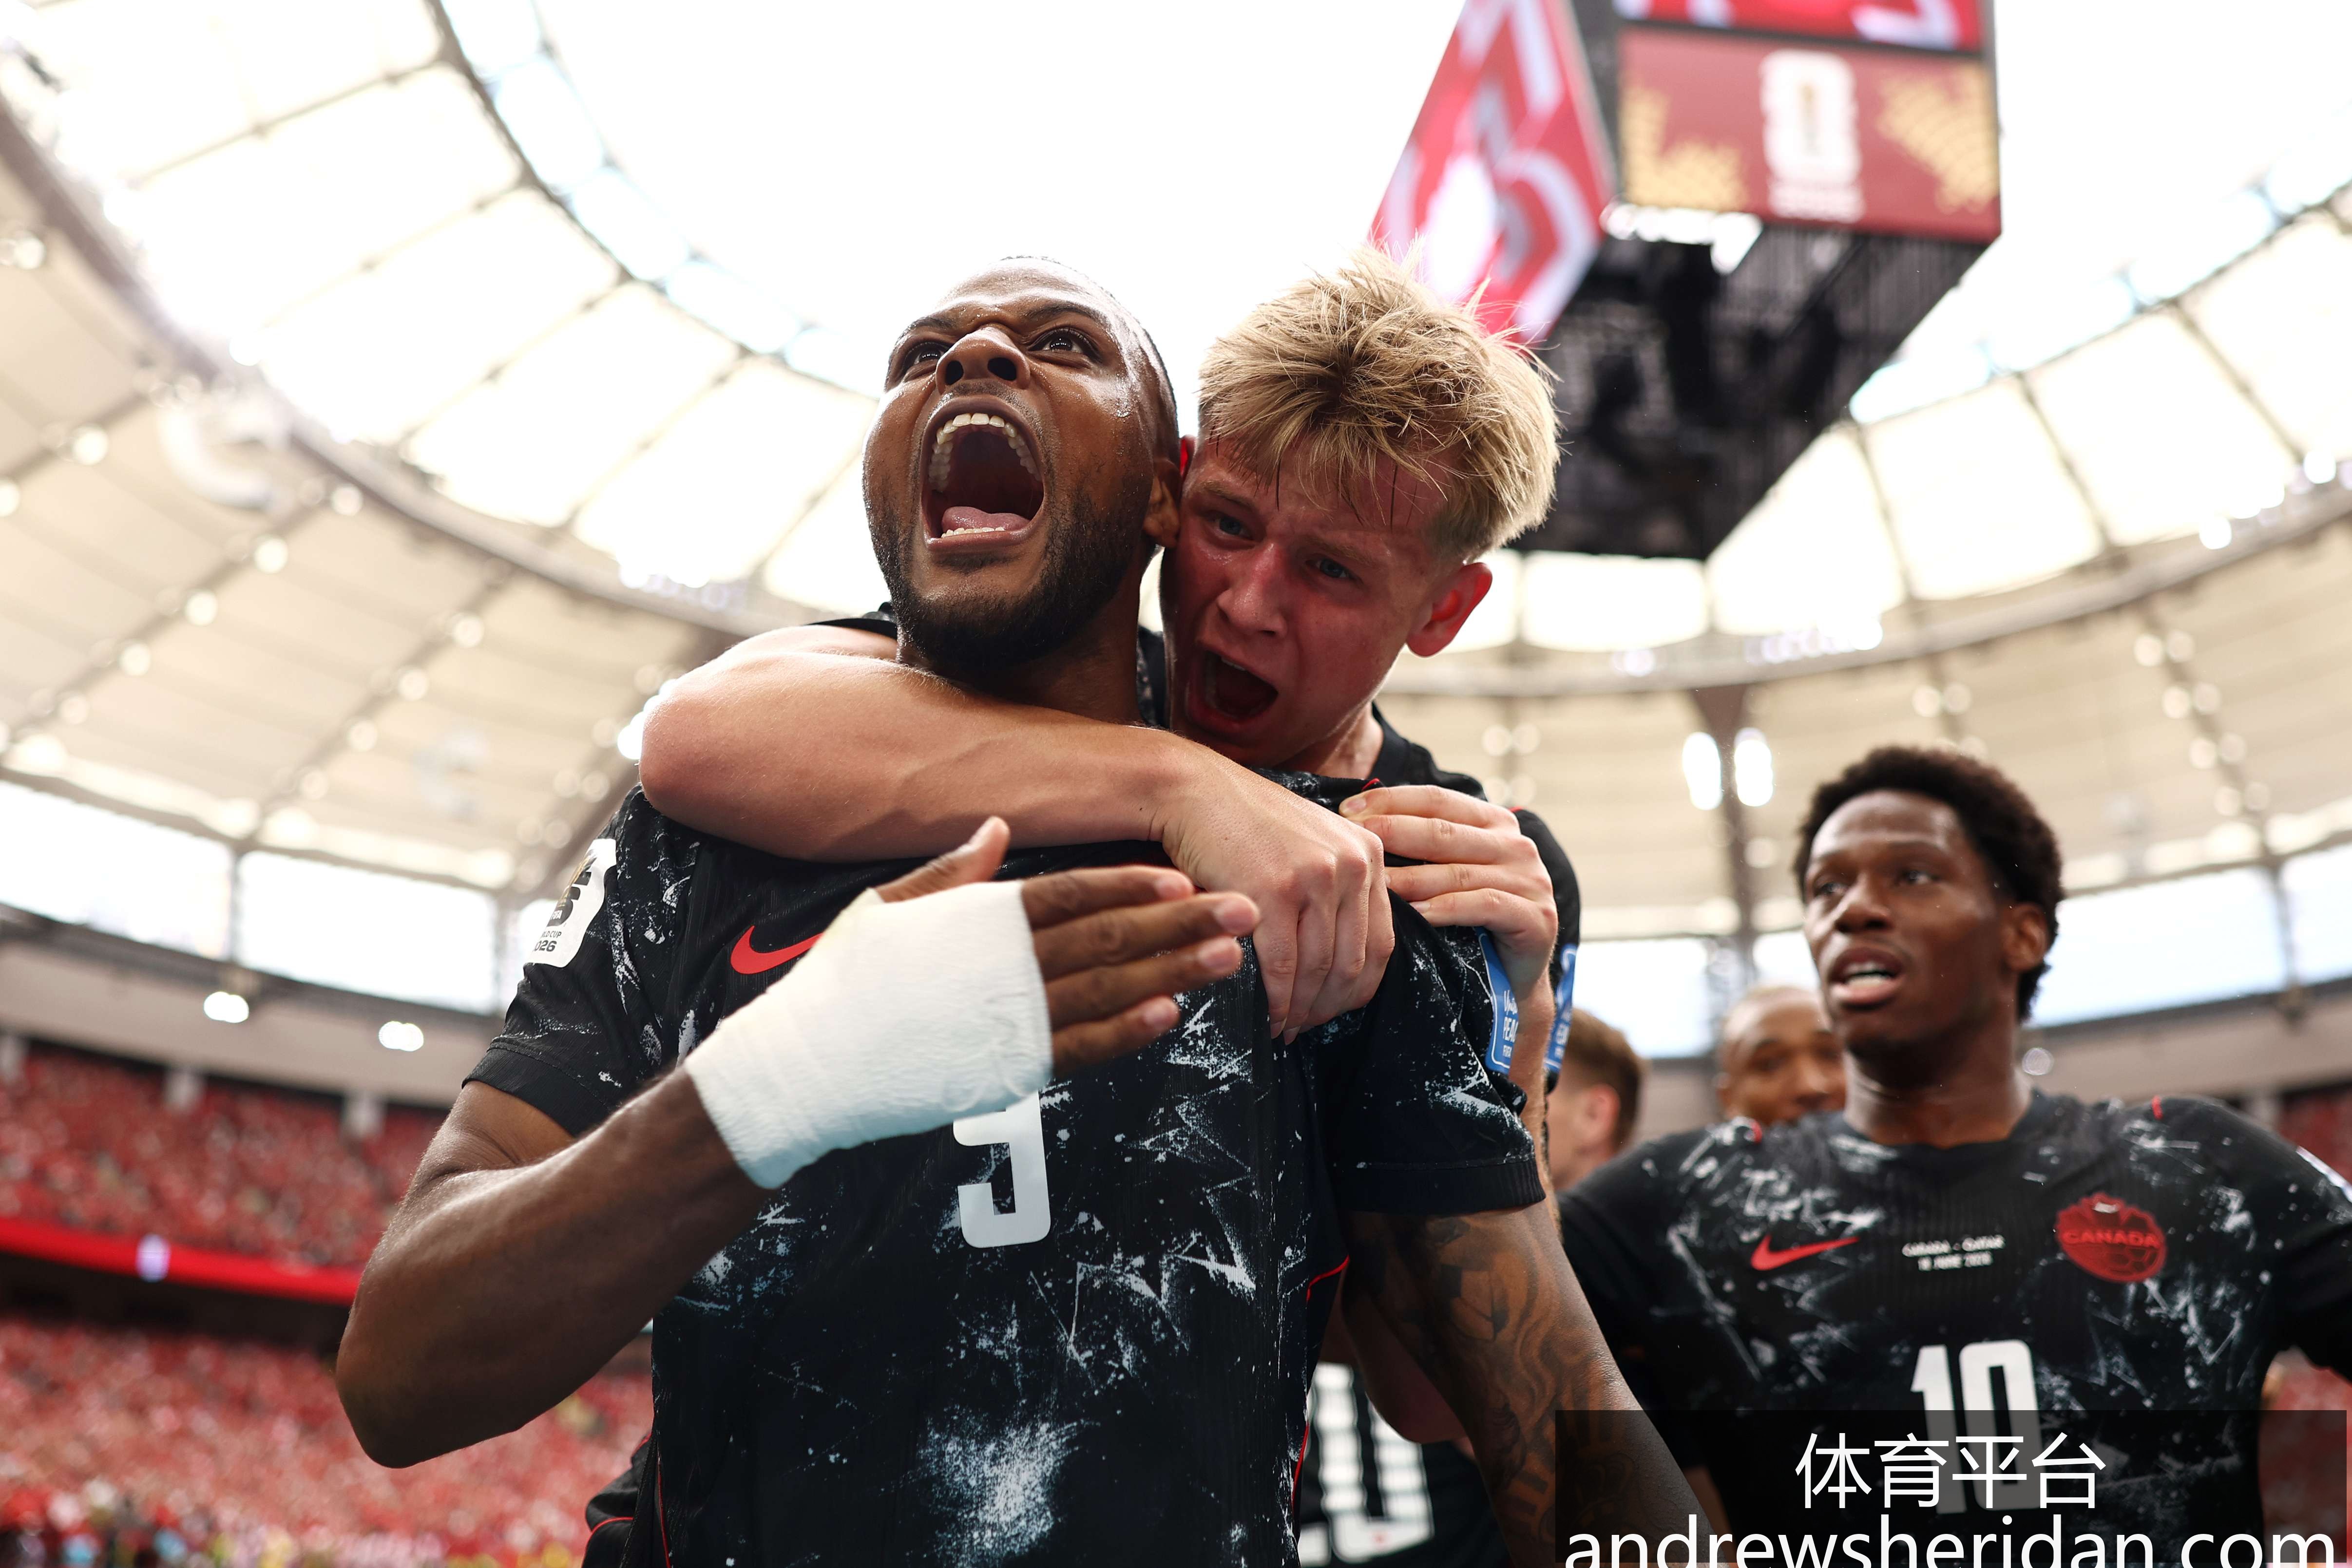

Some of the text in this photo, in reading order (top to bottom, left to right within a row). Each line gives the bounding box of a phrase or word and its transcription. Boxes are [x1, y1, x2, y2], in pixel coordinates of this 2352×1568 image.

[533, 940, 557, 952] 026
[2061, 1228, 2161, 1249] CANADA
[1297, 1362, 1435, 1565] 0
[1910, 1339, 2048, 1514] 10
